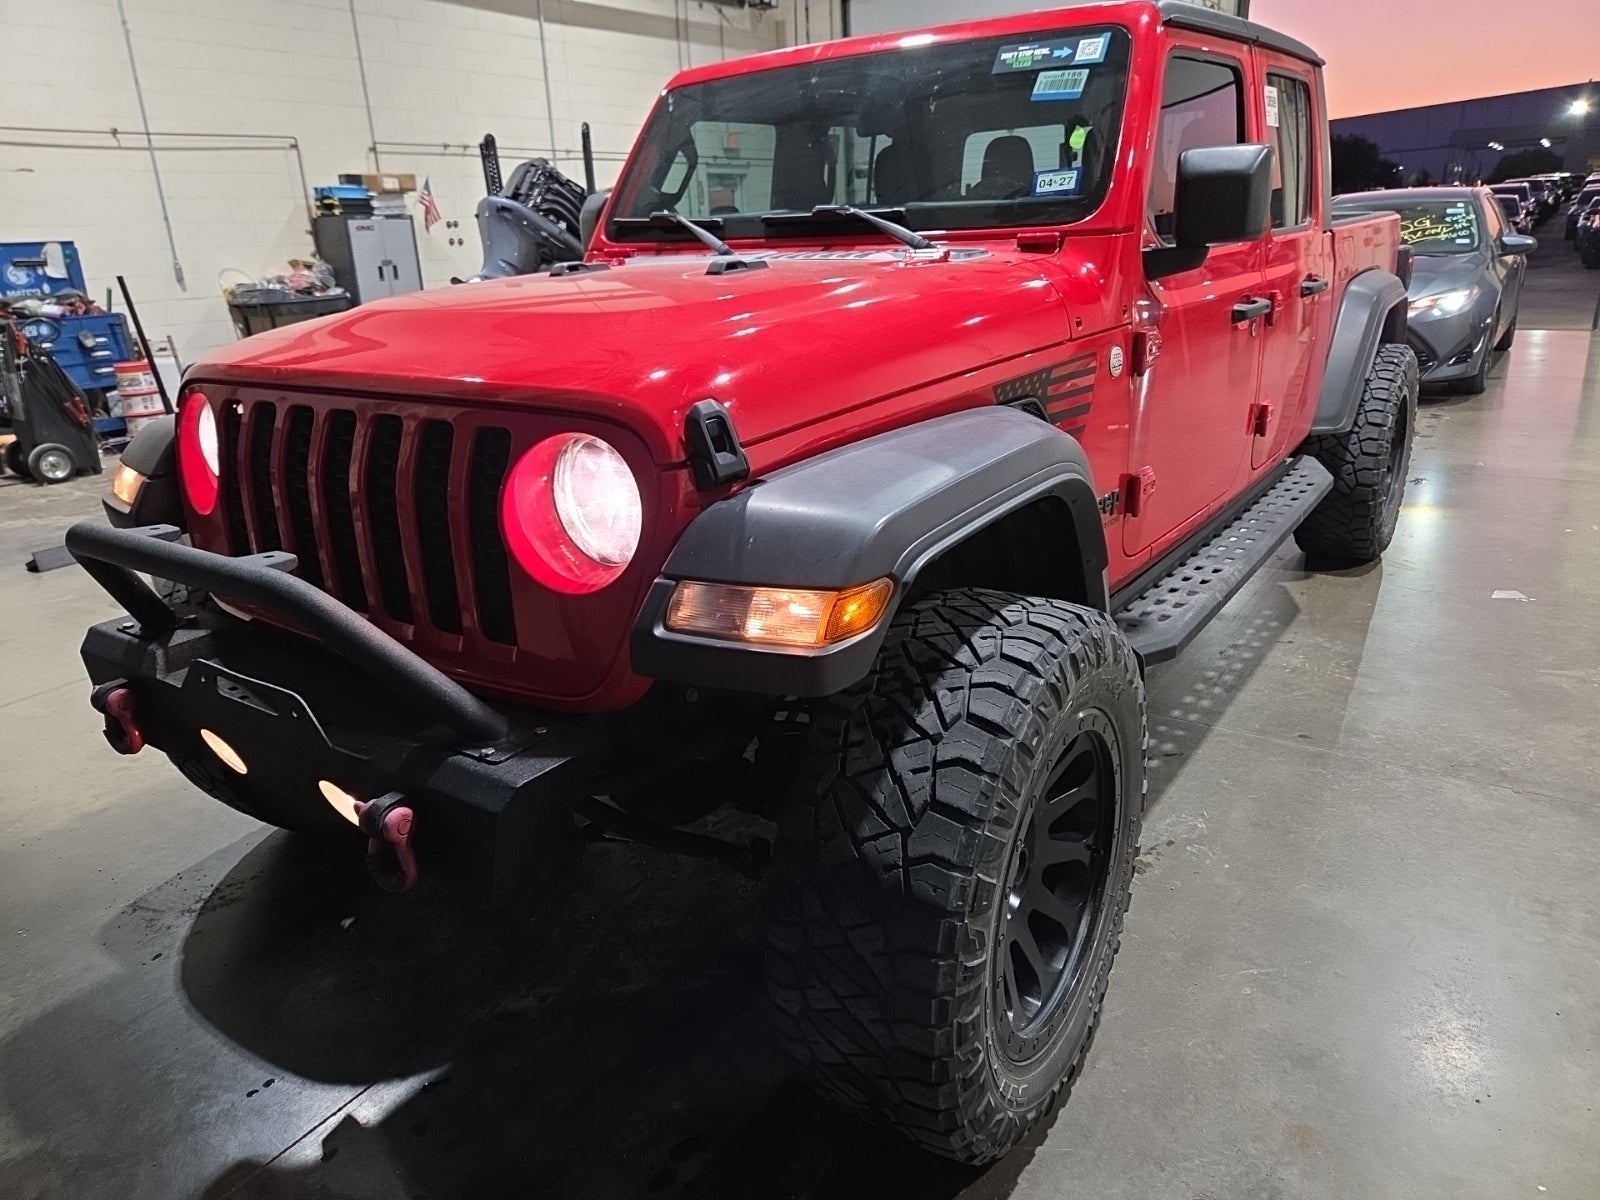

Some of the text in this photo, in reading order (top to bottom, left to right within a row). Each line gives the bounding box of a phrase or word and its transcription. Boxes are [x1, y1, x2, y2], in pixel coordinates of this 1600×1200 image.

[1039, 176, 1074, 189] 04 27
[1097, 489, 1119, 517] eep
